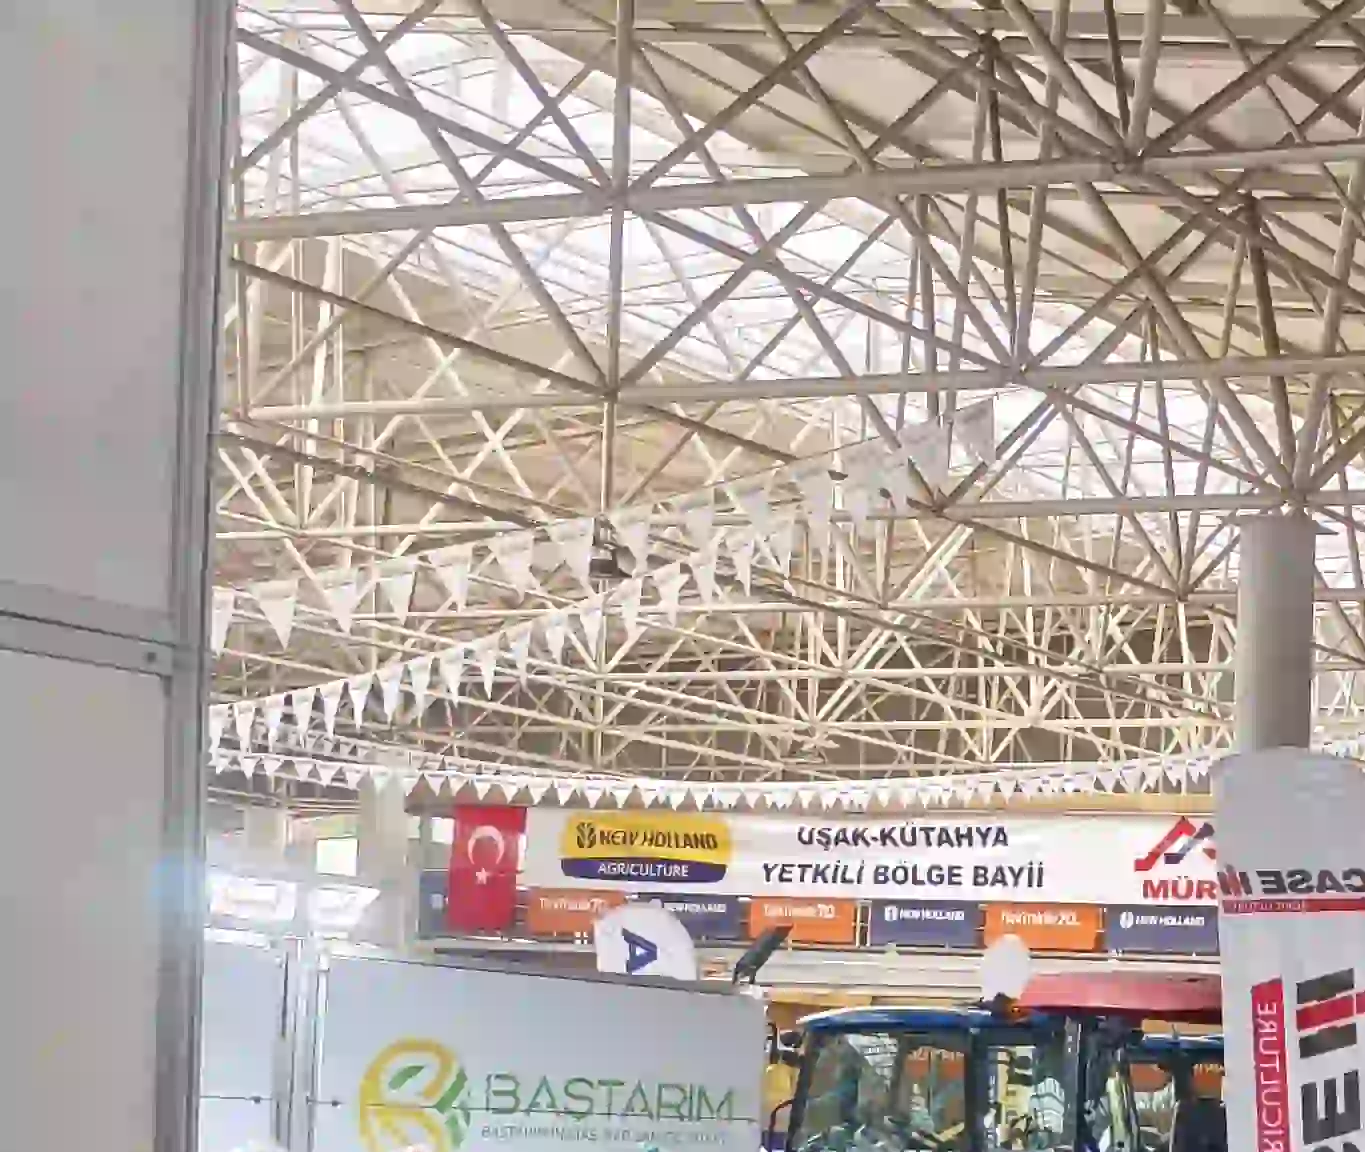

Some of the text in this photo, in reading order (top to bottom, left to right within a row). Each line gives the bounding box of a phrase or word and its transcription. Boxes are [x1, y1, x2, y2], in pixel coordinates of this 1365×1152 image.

[599, 829, 718, 850] NEW HOLLAND
[797, 821, 1009, 851] UŞAK-KÜTAHYA
[597, 862, 689, 877] AGRICULTURE
[762, 859, 1044, 888] YETKİLİ BÖLGE BAYİİ
[1142, 875, 1217, 899] MÜR
